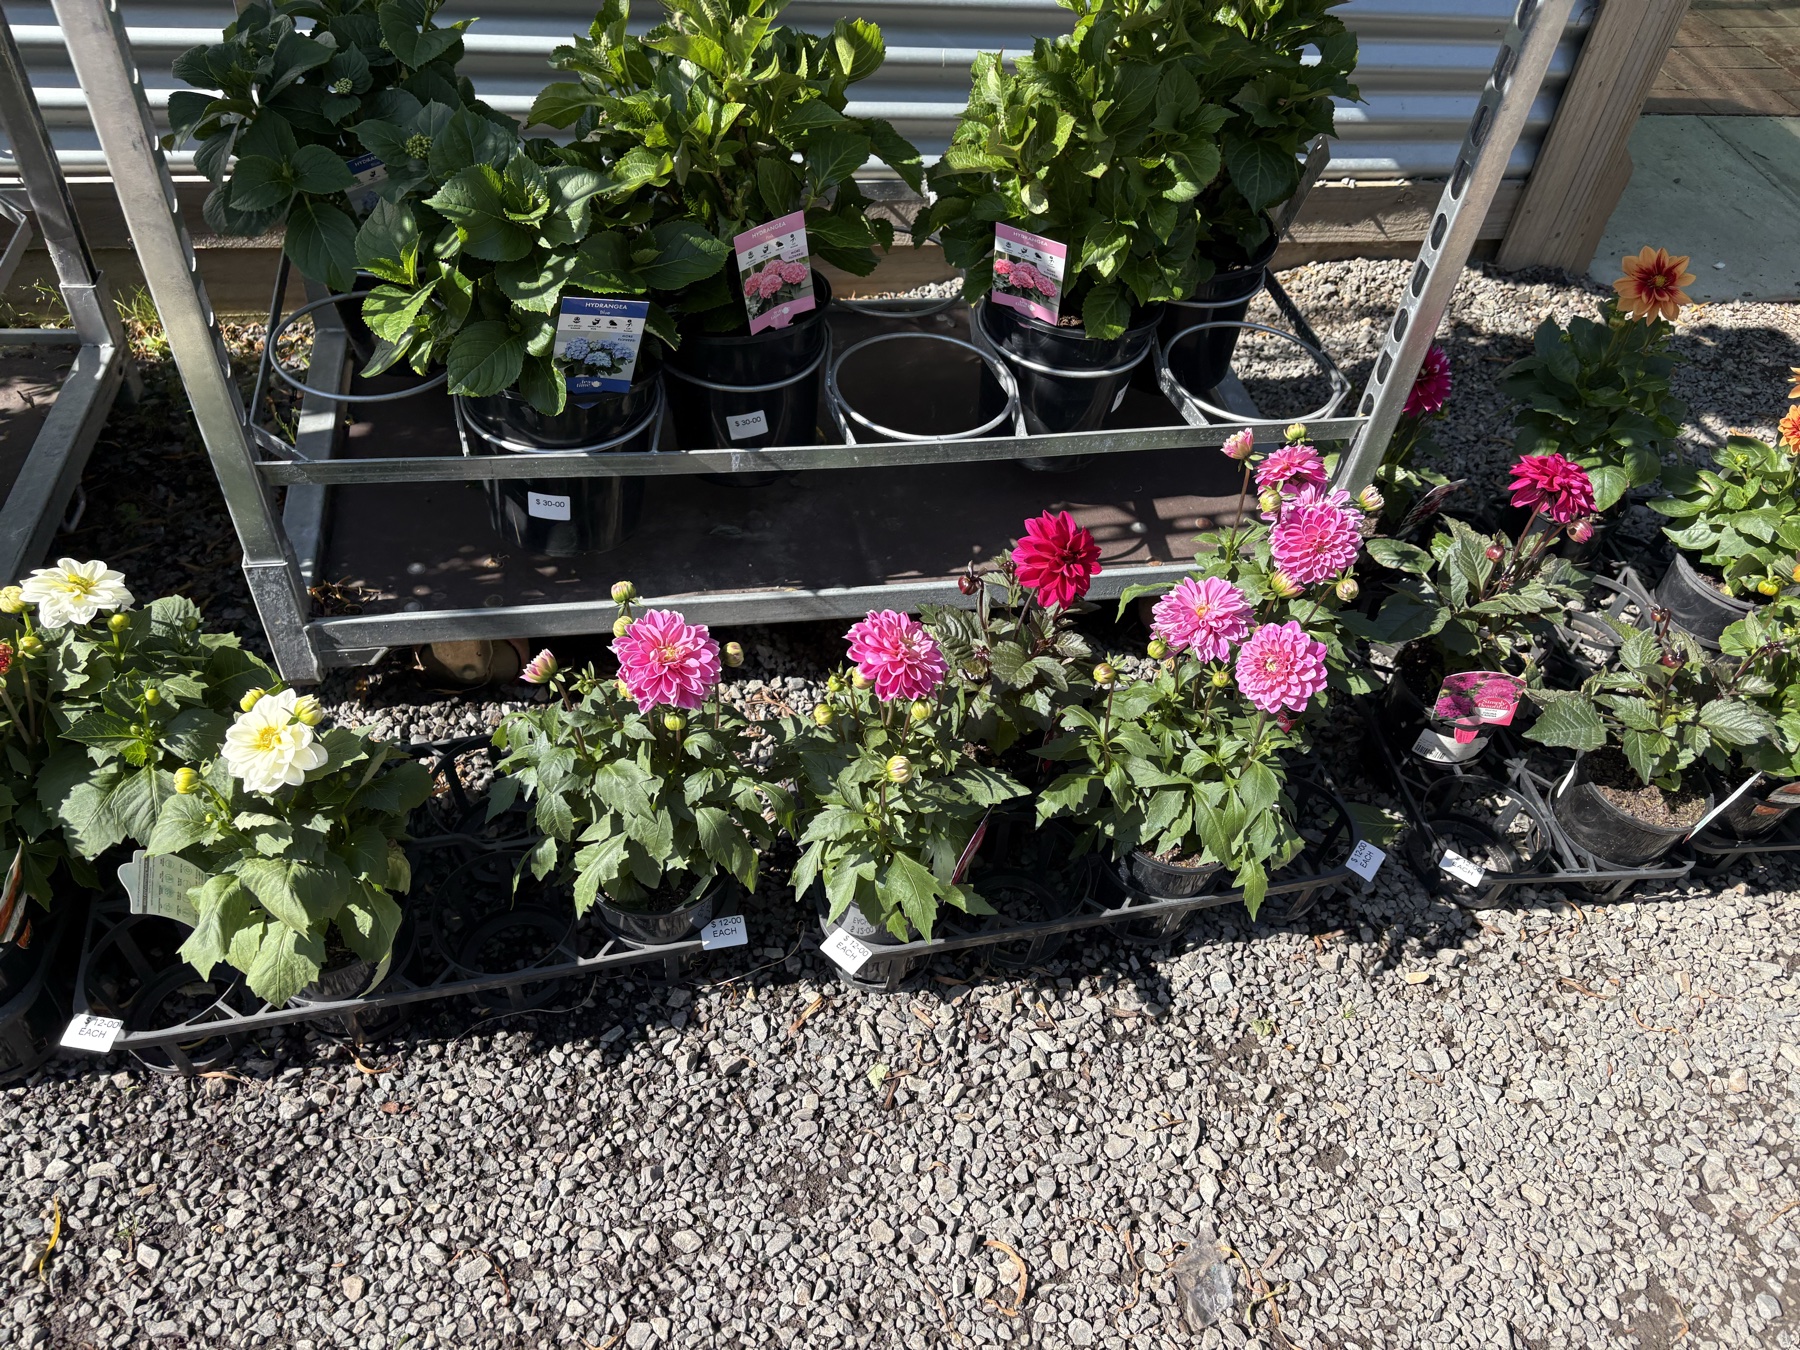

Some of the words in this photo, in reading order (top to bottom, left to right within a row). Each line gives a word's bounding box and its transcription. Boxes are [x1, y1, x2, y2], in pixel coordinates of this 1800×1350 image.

[751, 221, 787, 239] HYDRANGEA
[1013, 231, 1048, 247] HYDRANGEA
[585, 302, 628, 310] HYDRANGEA
[741, 416, 762, 426] 30-00
[542, 500, 565, 508] 30-00
[1354, 842, 1367, 857] 12-00
[1360, 850, 1374, 868] EACH
[1452, 861, 1474, 876] EACH
[719, 916, 742, 926] 12-00
[712, 927, 737, 938] EACH
[836, 941, 857, 961] EACH
[849, 940, 869, 957] 12-00
[84, 1017, 92, 1027] $
[94, 1019, 121, 1029] 12-00
[78, 1027, 107, 1038] EACH
